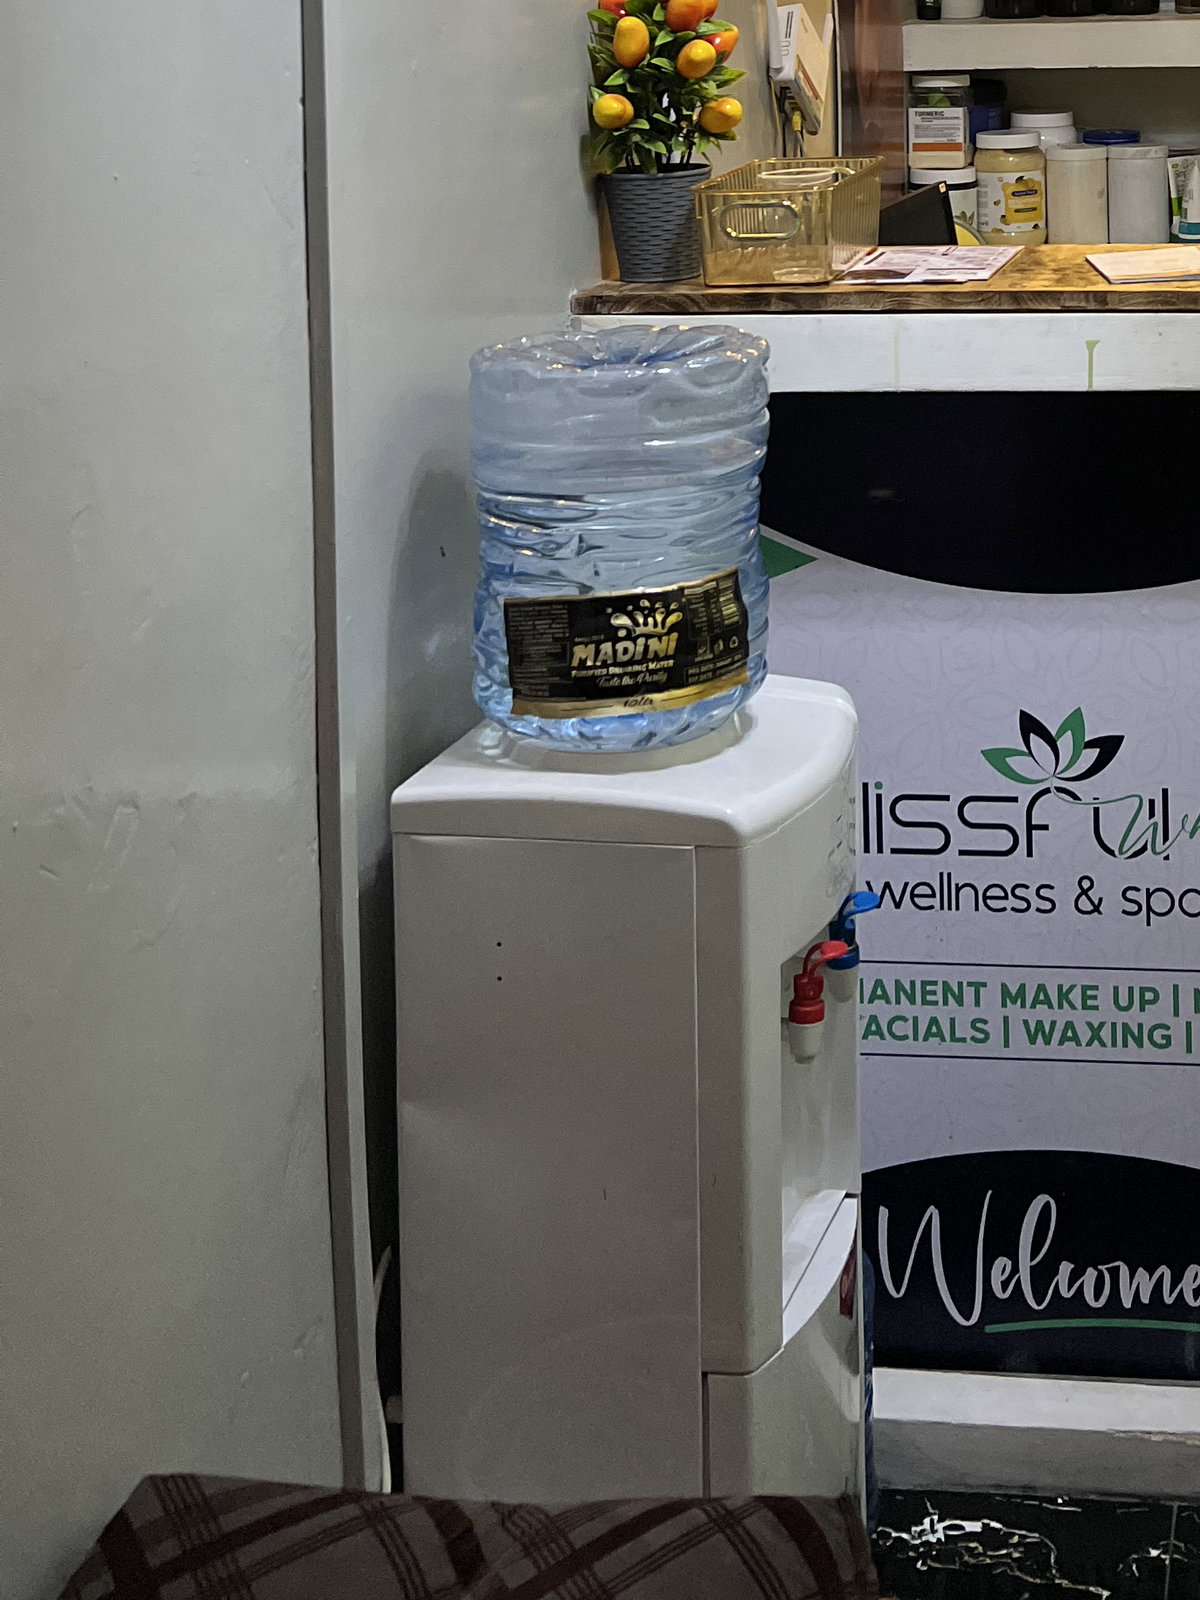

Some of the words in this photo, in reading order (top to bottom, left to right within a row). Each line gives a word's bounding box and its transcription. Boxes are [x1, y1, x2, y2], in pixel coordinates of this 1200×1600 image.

[571, 632, 679, 667] MADINI
[608, 664, 647, 675] DRINKING
[861, 782, 1170, 860] lissful
[865, 871, 1056, 915] wellness
[1073, 875, 1103, 916] &
[860, 977, 988, 1009] ANENT
[1001, 982, 1100, 1011] MAKE
[1112, 985, 1161, 1013] UP
[861, 1014, 991, 1045] ACIALS
[1022, 1018, 1173, 1050] WAXING
